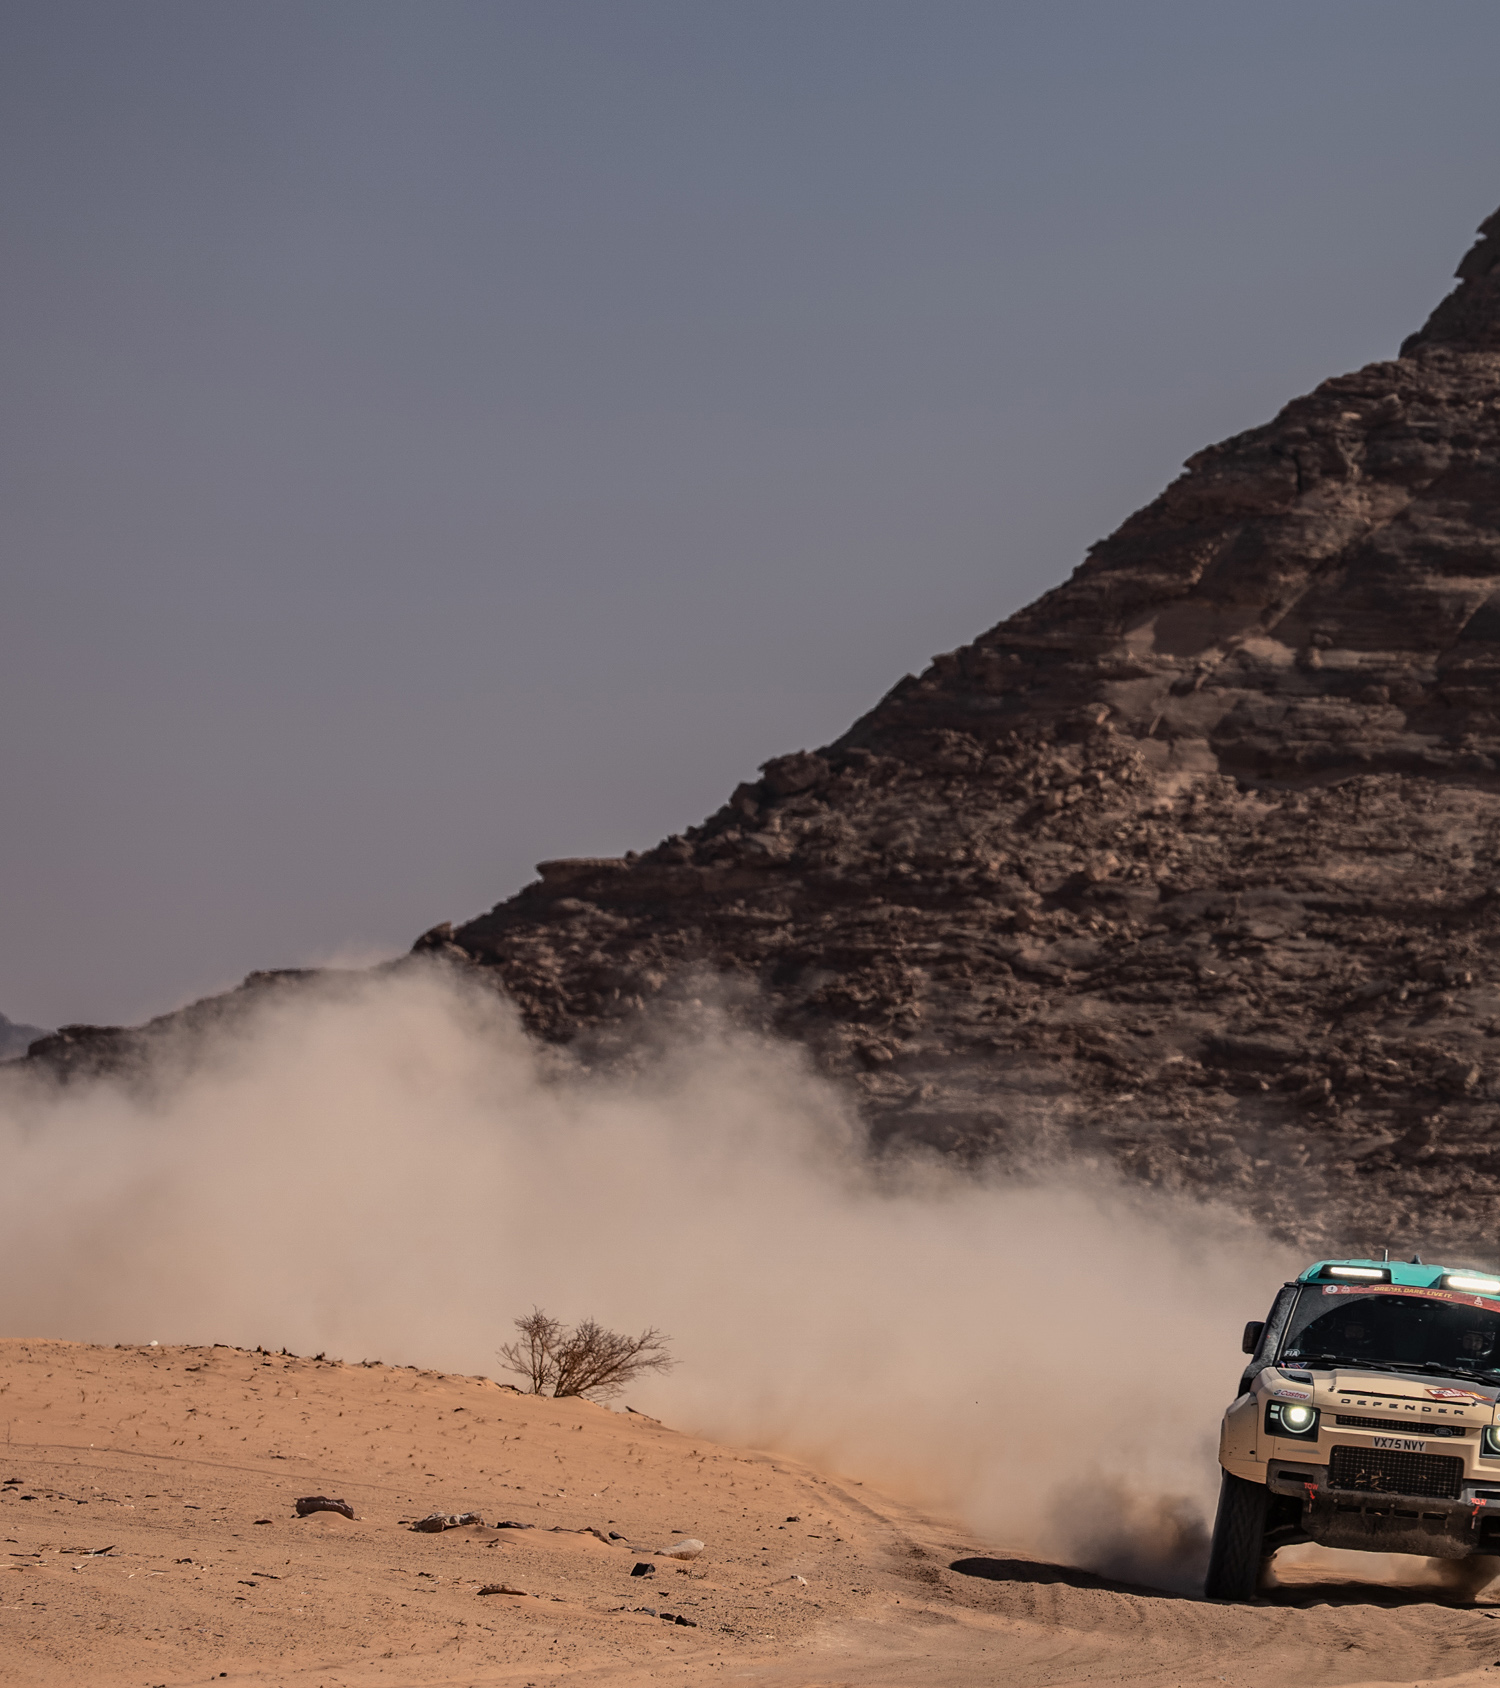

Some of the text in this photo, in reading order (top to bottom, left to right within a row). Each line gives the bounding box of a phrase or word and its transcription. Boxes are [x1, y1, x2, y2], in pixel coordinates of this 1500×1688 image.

[1281, 1390, 1308, 1399] Castrol
[1341, 1398, 1464, 1415] DEFENDER
[1374, 1437, 1425, 1451] VX75 NVY
[1304, 1482, 1318, 1490] TOW
[1470, 1497, 1487, 1506] TOW
